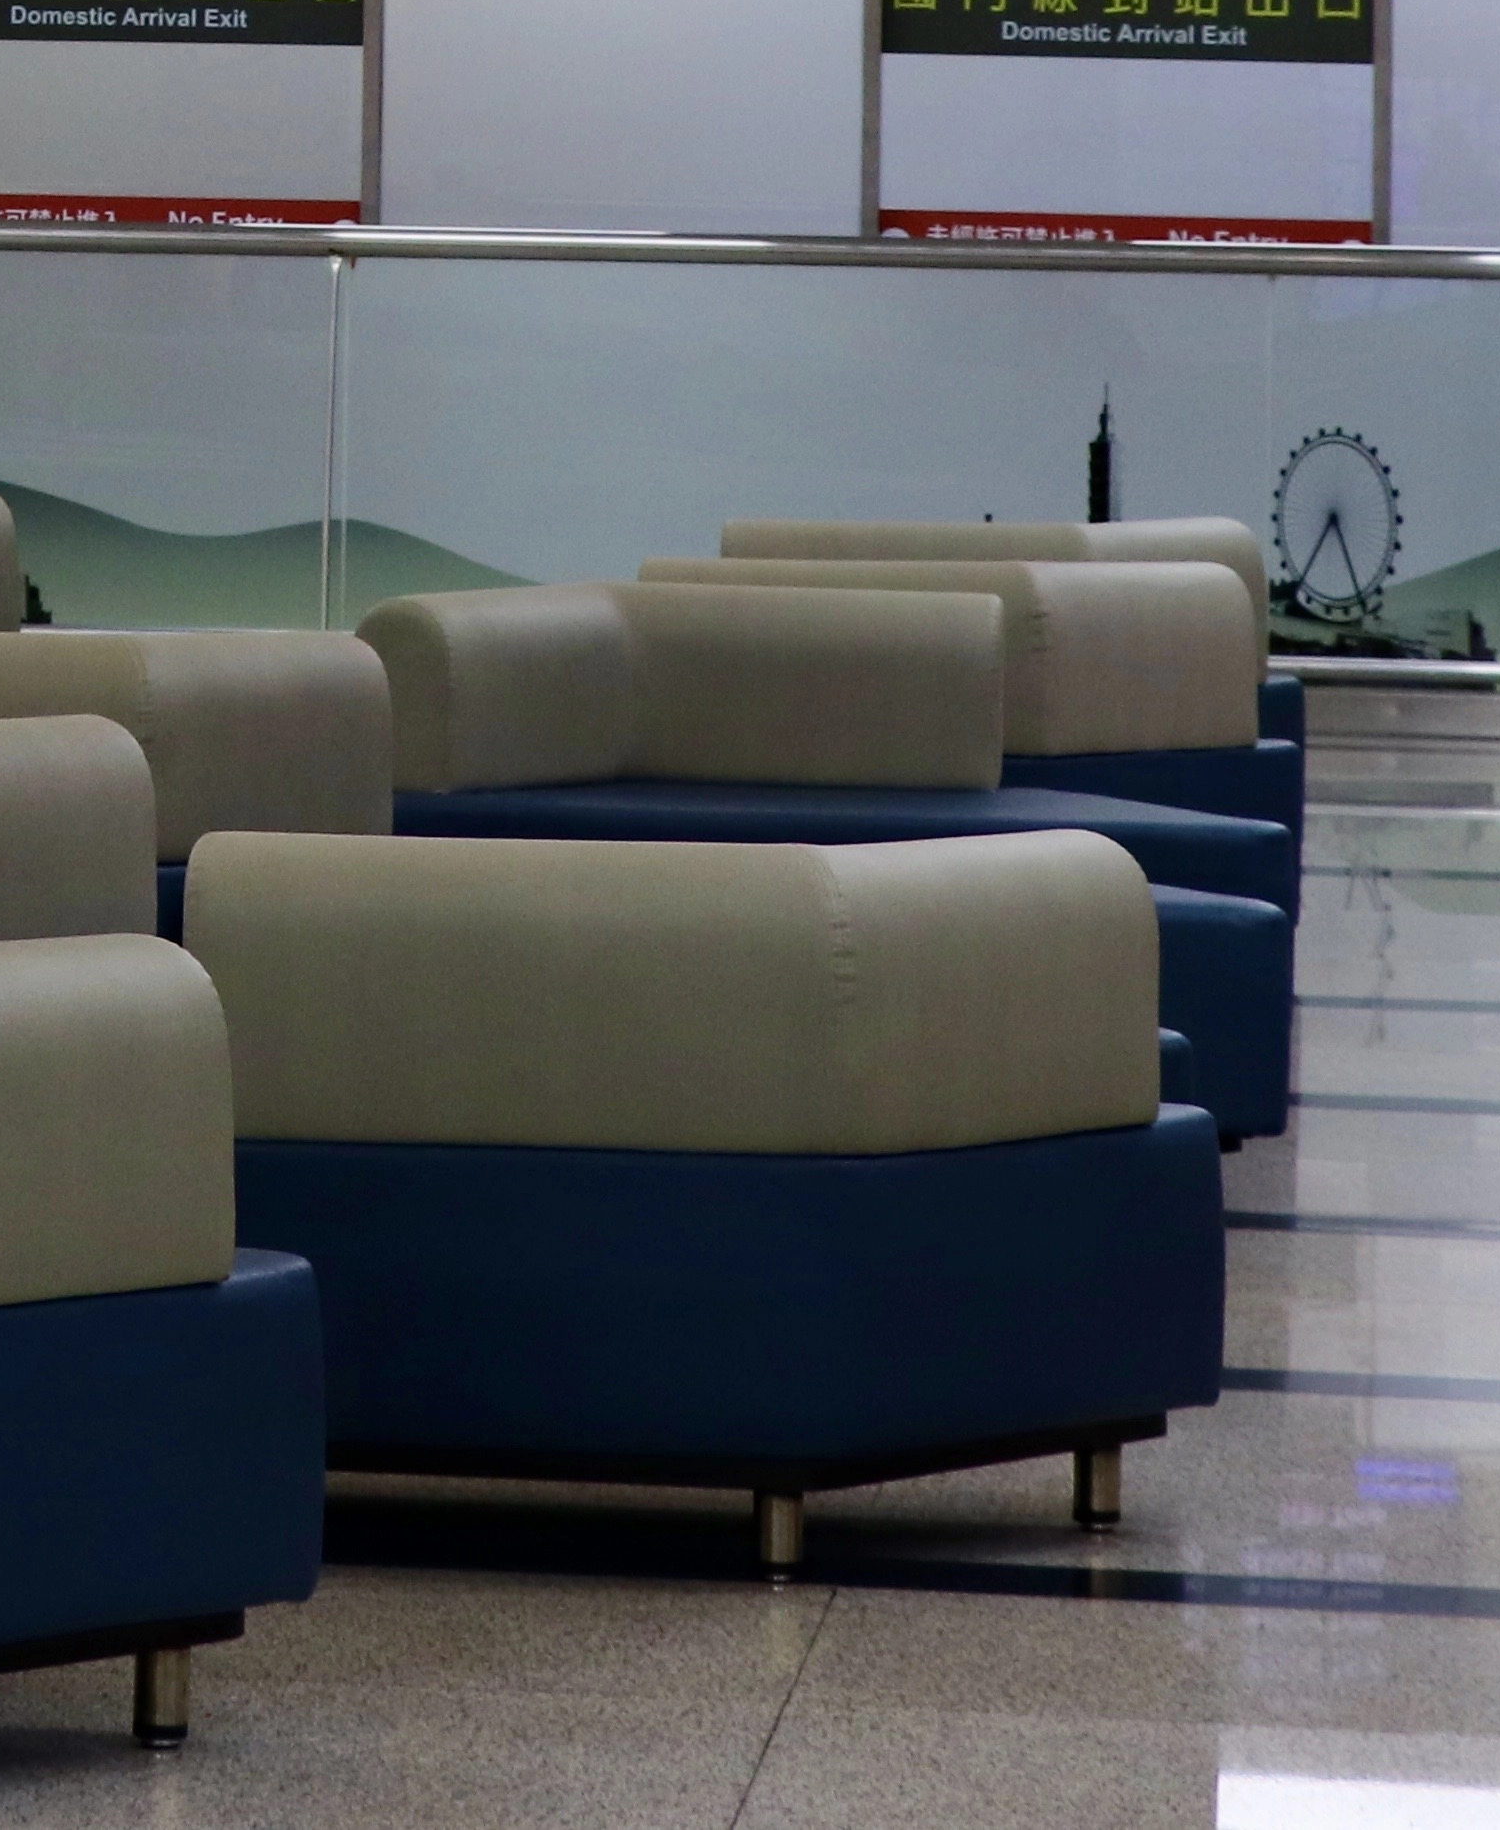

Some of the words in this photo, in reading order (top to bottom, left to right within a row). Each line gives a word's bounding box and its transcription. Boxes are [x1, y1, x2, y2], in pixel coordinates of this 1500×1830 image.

[11, 6, 116, 26] Domestic
[122, 7, 197, 27] Arrival
[204, 8, 247, 29] Exit
[1002, 22, 1110, 43] Domestic
[1117, 23, 1194, 45] Arrival
[1202, 24, 1247, 46] Exit
